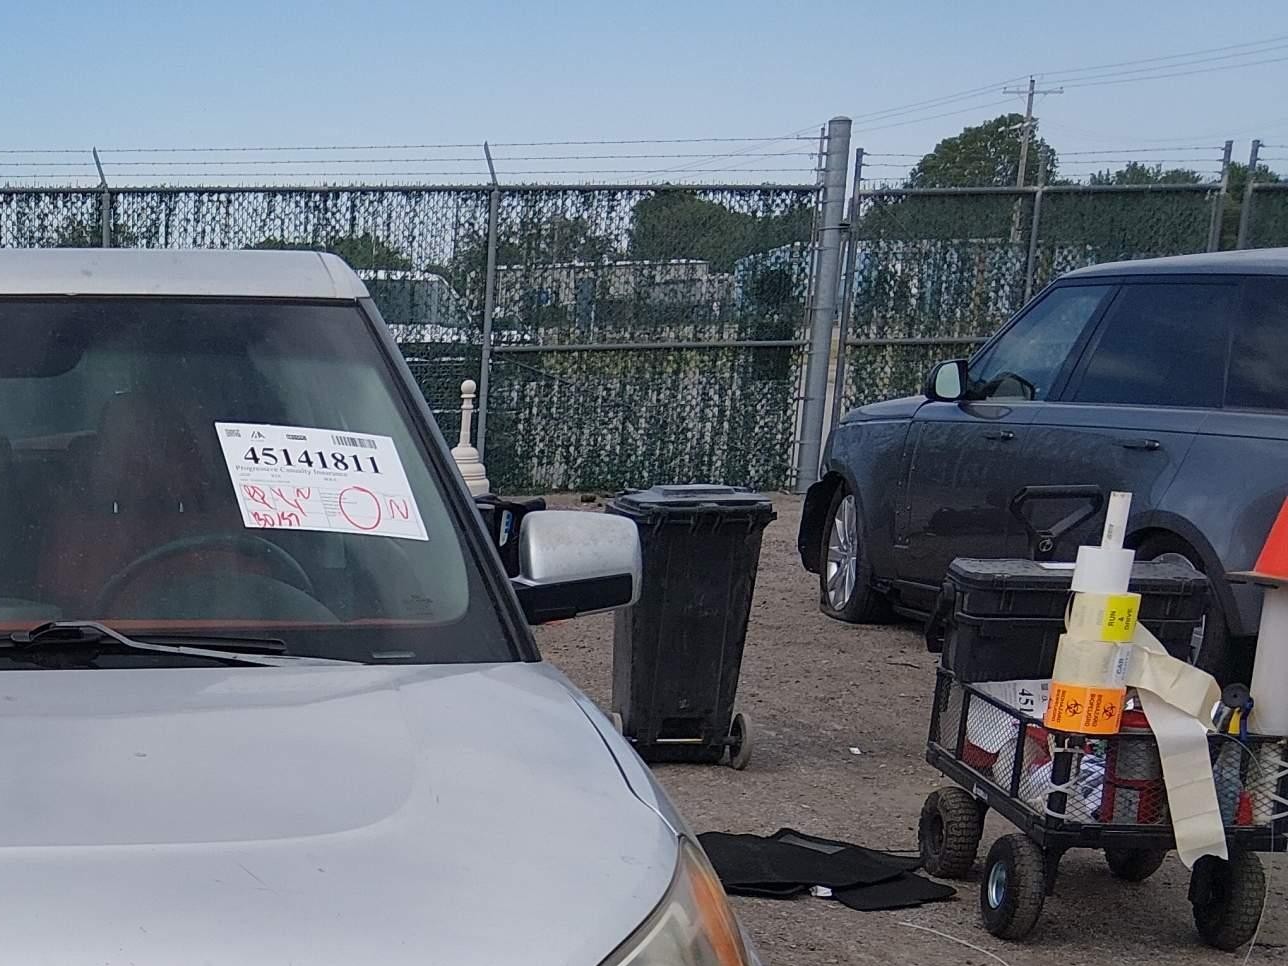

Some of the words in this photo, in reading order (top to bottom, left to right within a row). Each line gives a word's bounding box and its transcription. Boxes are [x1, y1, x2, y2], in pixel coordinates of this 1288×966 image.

[244, 446, 383, 474] 45141811
[1108, 610, 1117, 627] RUN
[1124, 608, 1134, 631] DRIVE
